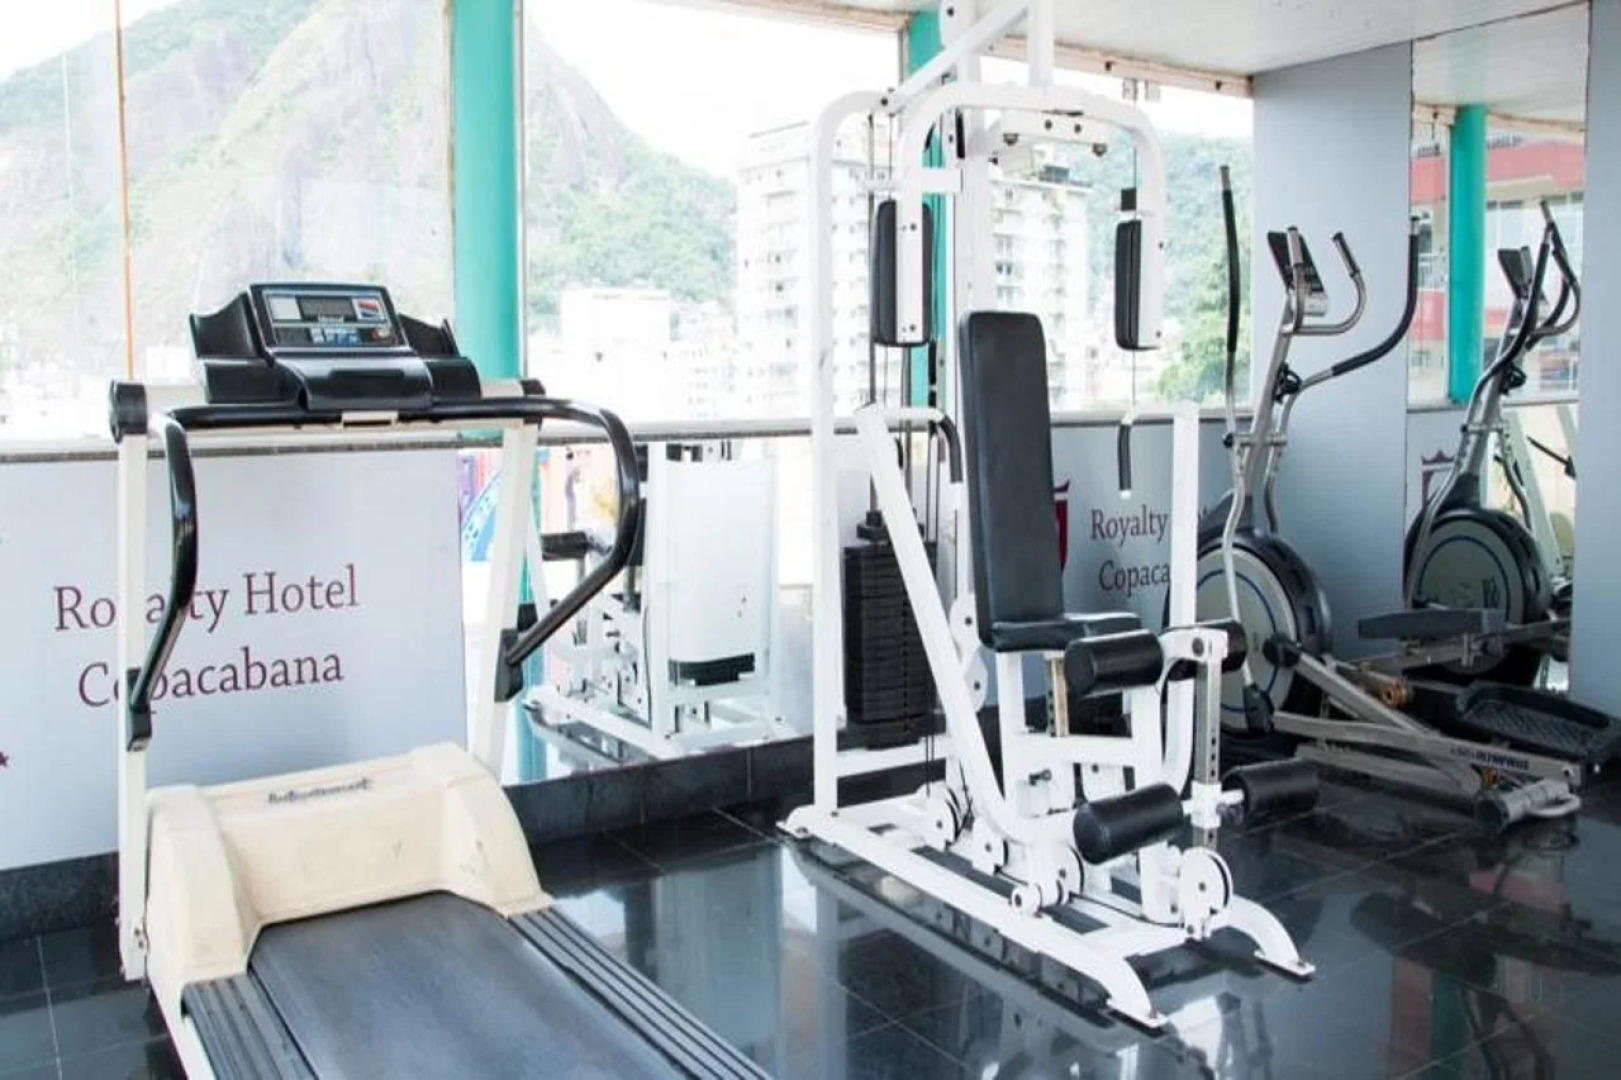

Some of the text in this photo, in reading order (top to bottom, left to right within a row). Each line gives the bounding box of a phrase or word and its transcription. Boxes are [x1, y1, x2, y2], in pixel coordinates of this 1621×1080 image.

[1091, 504, 1169, 548] Royalty
[53, 563, 359, 634] Roaty Hotel
[78, 644, 345, 714] Cpacabana
